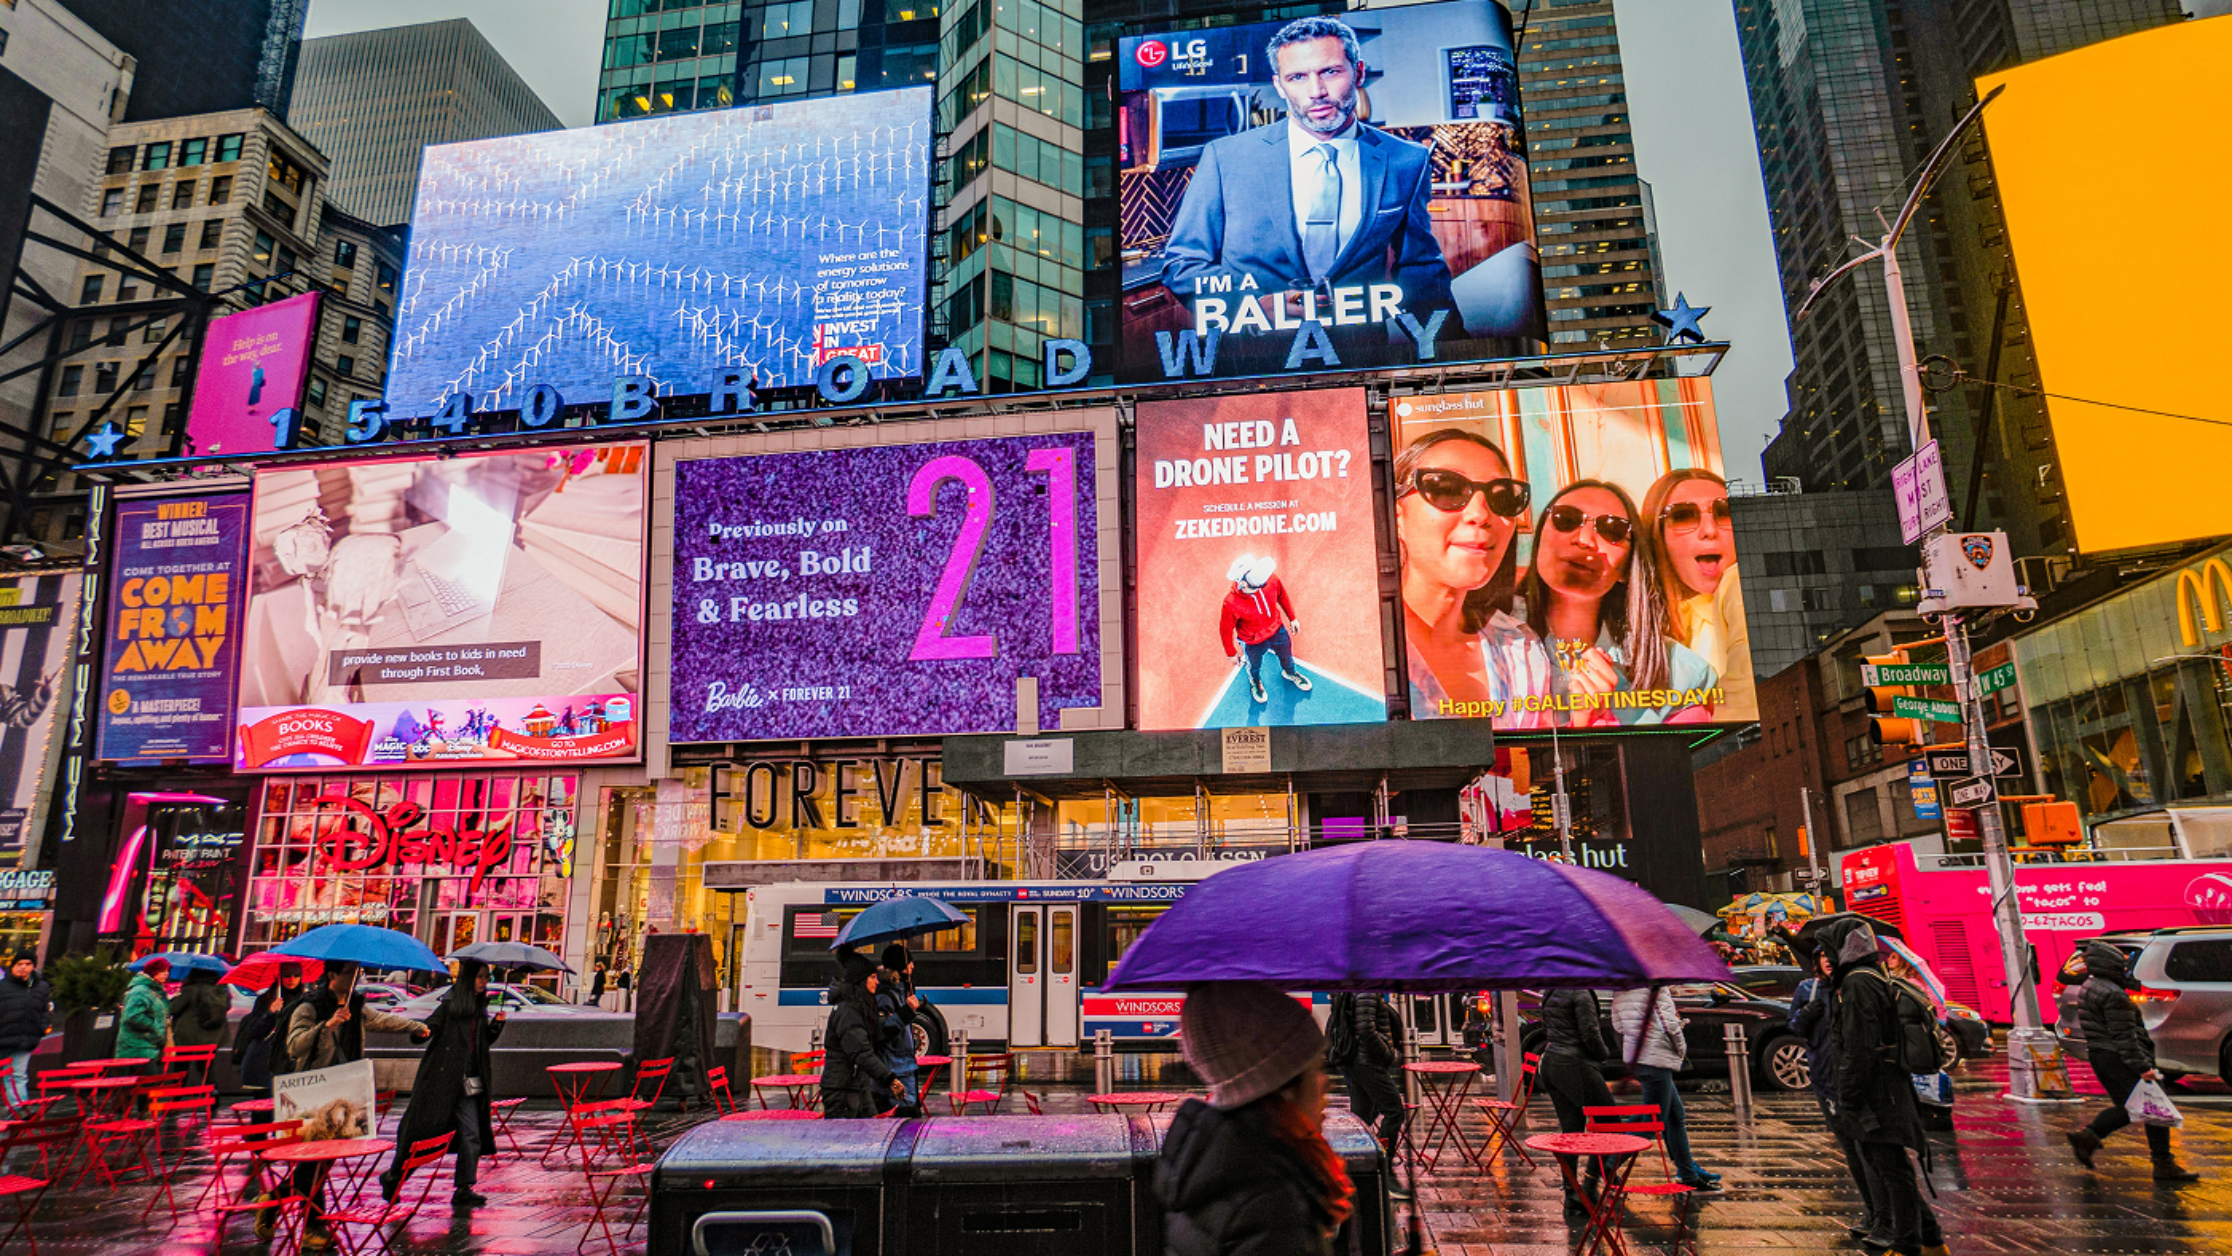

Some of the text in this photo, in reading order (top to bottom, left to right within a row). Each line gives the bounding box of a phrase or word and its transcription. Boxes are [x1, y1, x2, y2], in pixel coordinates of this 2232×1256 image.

[1172, 39, 1206, 60] LG
[1193, 59, 1213, 68] Good
[819, 248, 899, 264] Where are the
[818, 261, 909, 278] energy solutions
[817, 277, 888, 291] of tomorrow
[1195, 273, 1260, 295] I'M A
[866, 287, 906, 300] today?
[824, 320, 879, 334] INVEST
[233, 332, 278, 351] Help is on
[824, 336, 839, 348] IN
[223, 354, 238, 366] the
[260, 343, 282, 356] dear.
[1415, 398, 1485, 415] sunglass hut
[1204, 418, 1300, 450] NEED A
[1155, 450, 1351, 489] DRONE PILOT?
[1918, 452, 1938, 474] LANE
[158, 502, 208, 520] WINNER!
[1203, 500, 1299, 513] SCHEDULE A MISSION AT
[1924, 497, 1946, 519] RIGHT
[142, 518, 219, 539] BEST MUSICAL
[709, 516, 848, 541] Previously on
[1175, 511, 1337, 540] ZEKEDRONE.COM
[908, 447, 1079, 661] 21
[124, 562, 231, 576] COME TOGETHER AT
[693, 547, 873, 583] Brave, Bold
[121, 573, 229, 608] COME
[696, 593, 859, 624] & Fearless
[113, 637, 225, 673] AWAY
[343, 647, 527, 667] provide new books to kids in need
[381, 665, 485, 680] through First Book,
[1881, 666, 1947, 685] Broadway
[1982, 678, 1991, 692] W
[1994, 669, 2005, 686] 45
[140, 698, 201, 712] MASTERPIECE!
[705, 682, 851, 713] Barbie FOREVER 21
[1438, 688, 1725, 718] Happy #GALENTINESDAY!!
[1897, 698, 1960, 715] George Abbott
[279, 719, 334, 735] BOOKS
[374, 742, 407, 751] MAGIC
[501, 738, 626, 758] MAGICOFSTORYTELLING.COM
[1226, 734, 1266, 744] EVEREST
[412, 744, 431, 753] abc
[1940, 758, 1966, 769] ONE
[710, 758, 992, 831] FOREVE
[1957, 788, 1970, 800] ONE
[1581, 842, 1629, 868] hut
[1043, 889, 1076, 898] SUNDAYS
[1111, 886, 1185, 898] WINDSORS
[2044, 880, 2107, 893] gets fed!
[2083, 896, 2100, 906] to
[1116, 1002, 1180, 1012] WINDSORS
[279, 1074, 326, 1090] ARITZIA
